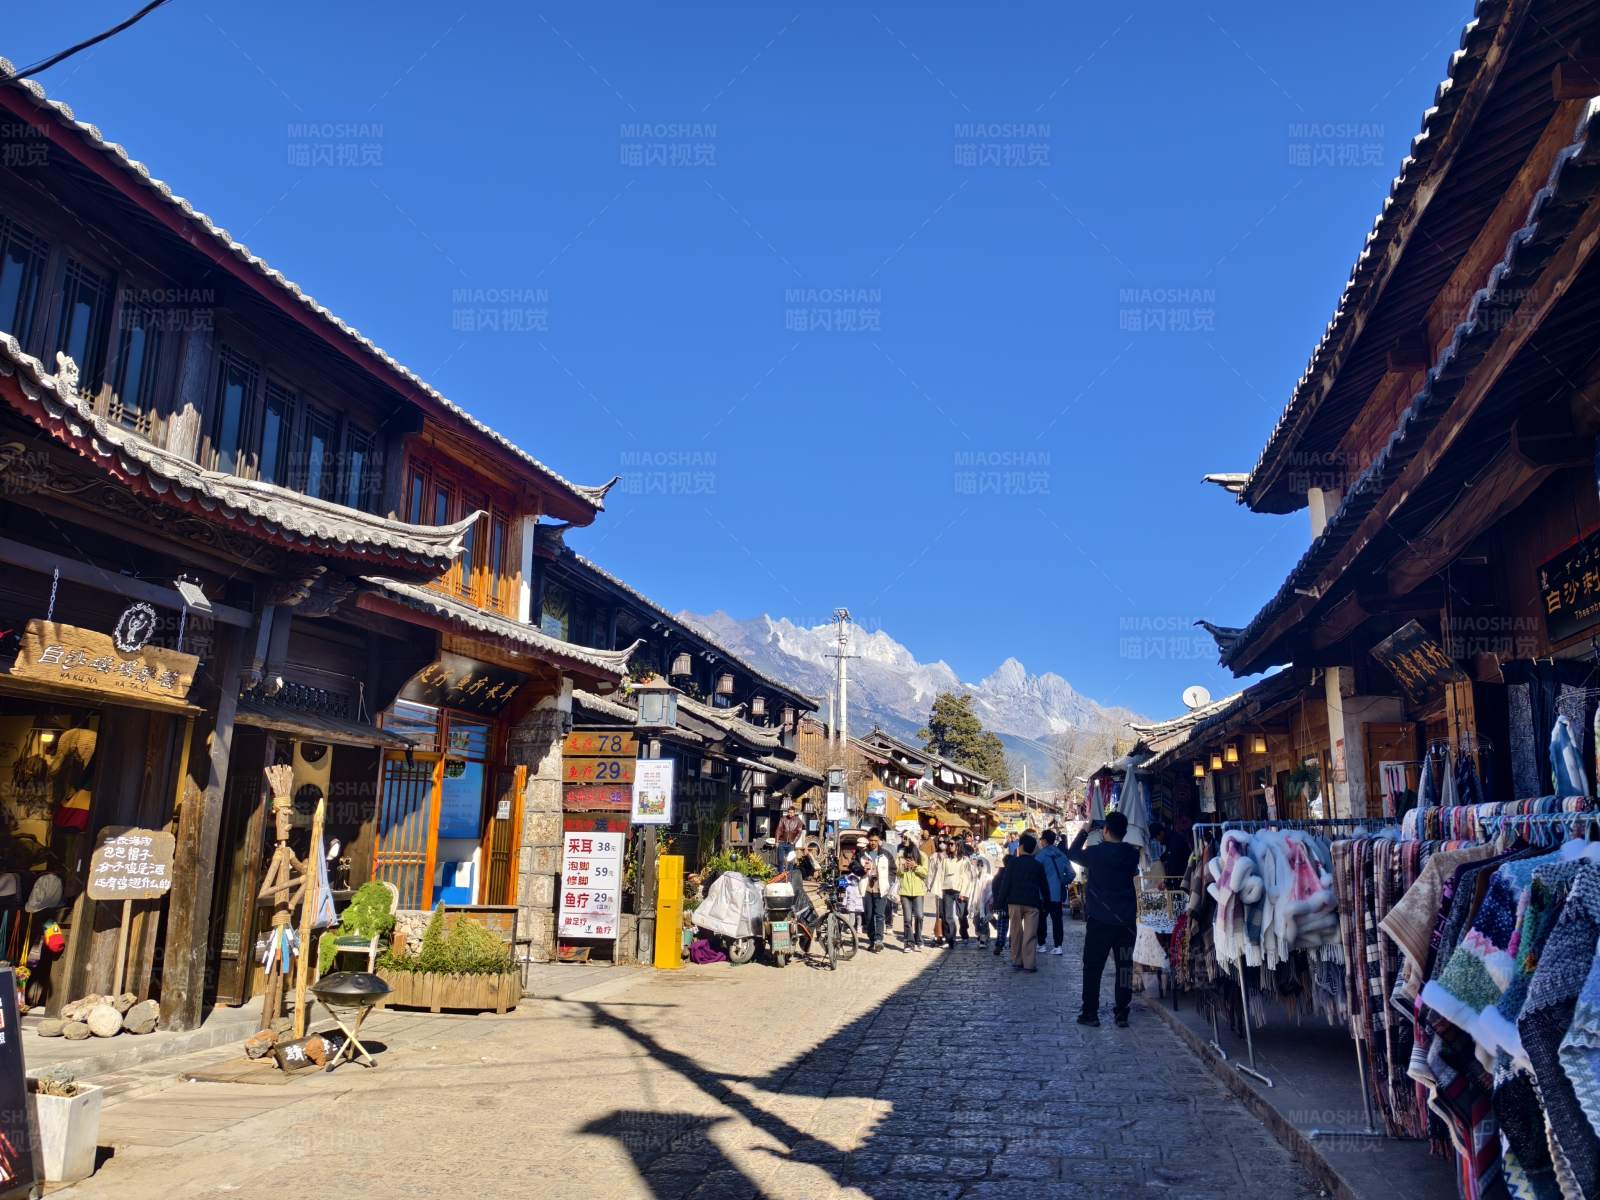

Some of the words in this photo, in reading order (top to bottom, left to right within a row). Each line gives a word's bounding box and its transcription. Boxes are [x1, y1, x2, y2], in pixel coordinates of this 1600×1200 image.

[598, 735, 622, 752] 78
[595, 761, 620, 779] 29
[568, 838, 593, 854] 采耳
[597, 842, 611, 852] 38
[567, 861, 590, 871] 泡脚
[595, 867, 608, 877] 59
[566, 876, 589, 886] 修脚
[564, 892, 590, 909] 鱼疗
[593, 893, 608, 902] 29
